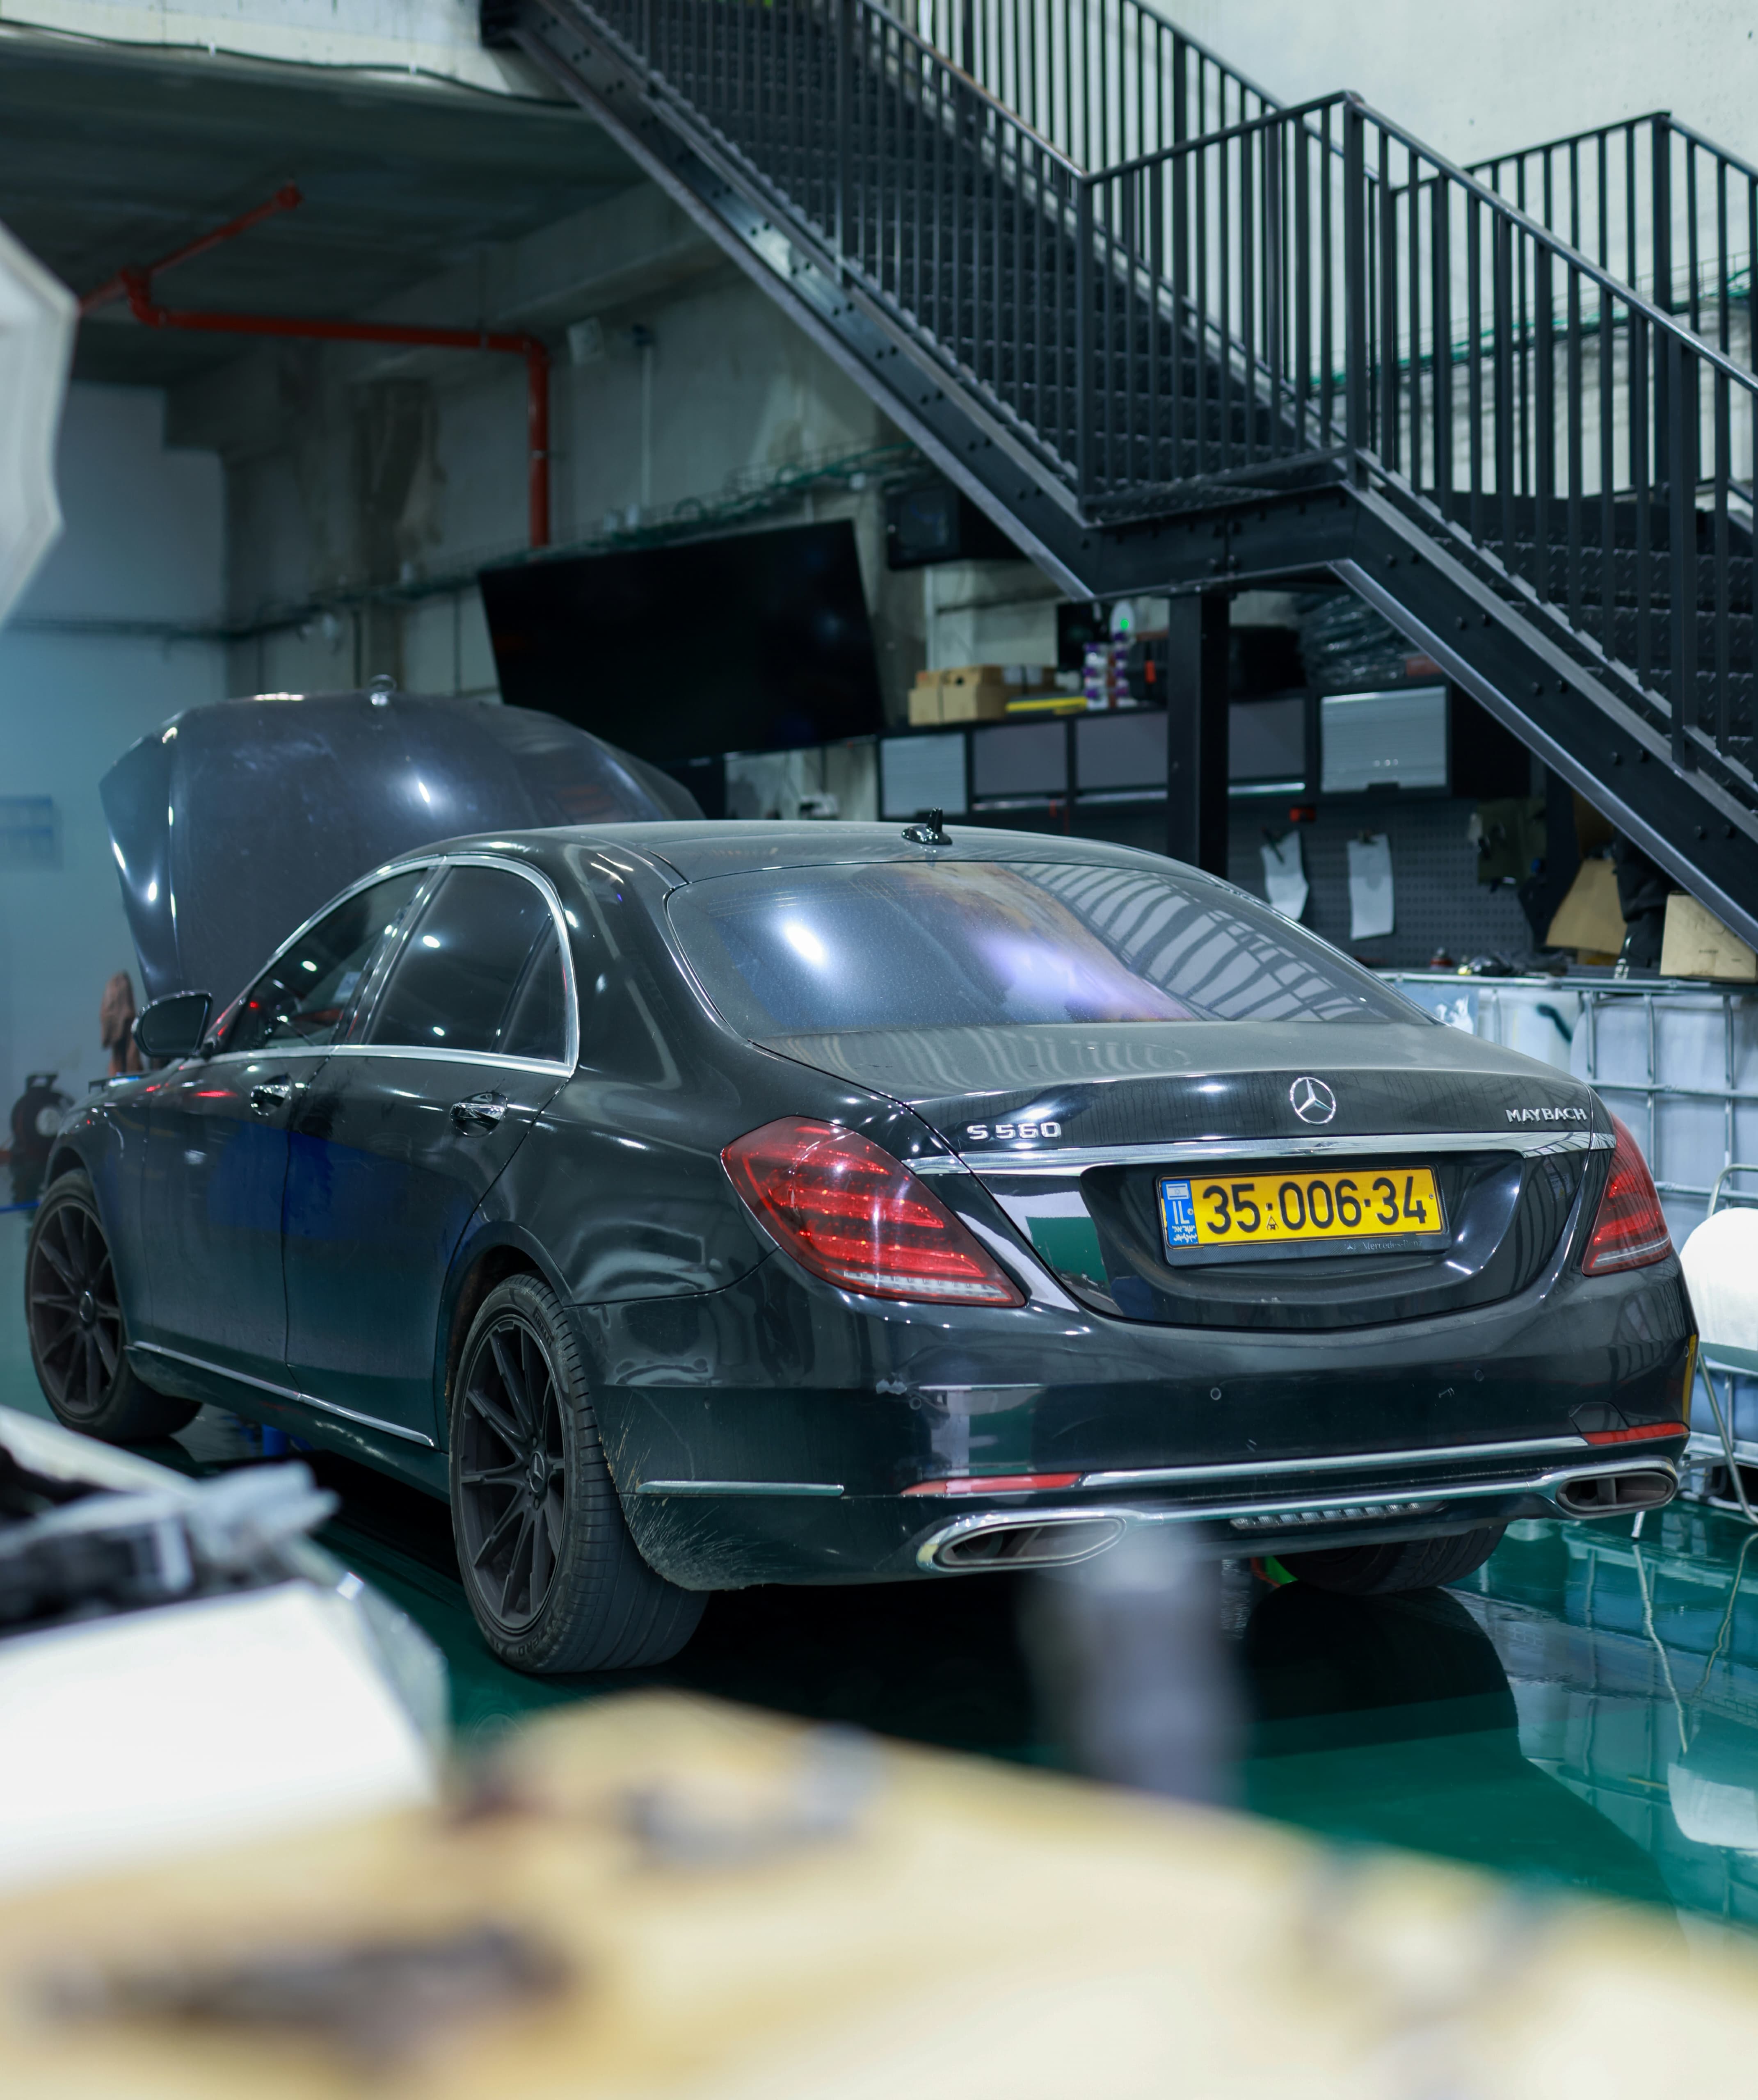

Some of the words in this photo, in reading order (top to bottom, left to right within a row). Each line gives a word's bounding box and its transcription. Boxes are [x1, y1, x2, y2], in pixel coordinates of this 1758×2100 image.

[1505, 1108, 1587, 1123] MAYBACH
[967, 1125, 988, 1140] S
[995, 1122, 1061, 1139] 560
[1173, 1201, 1190, 1224] IL
